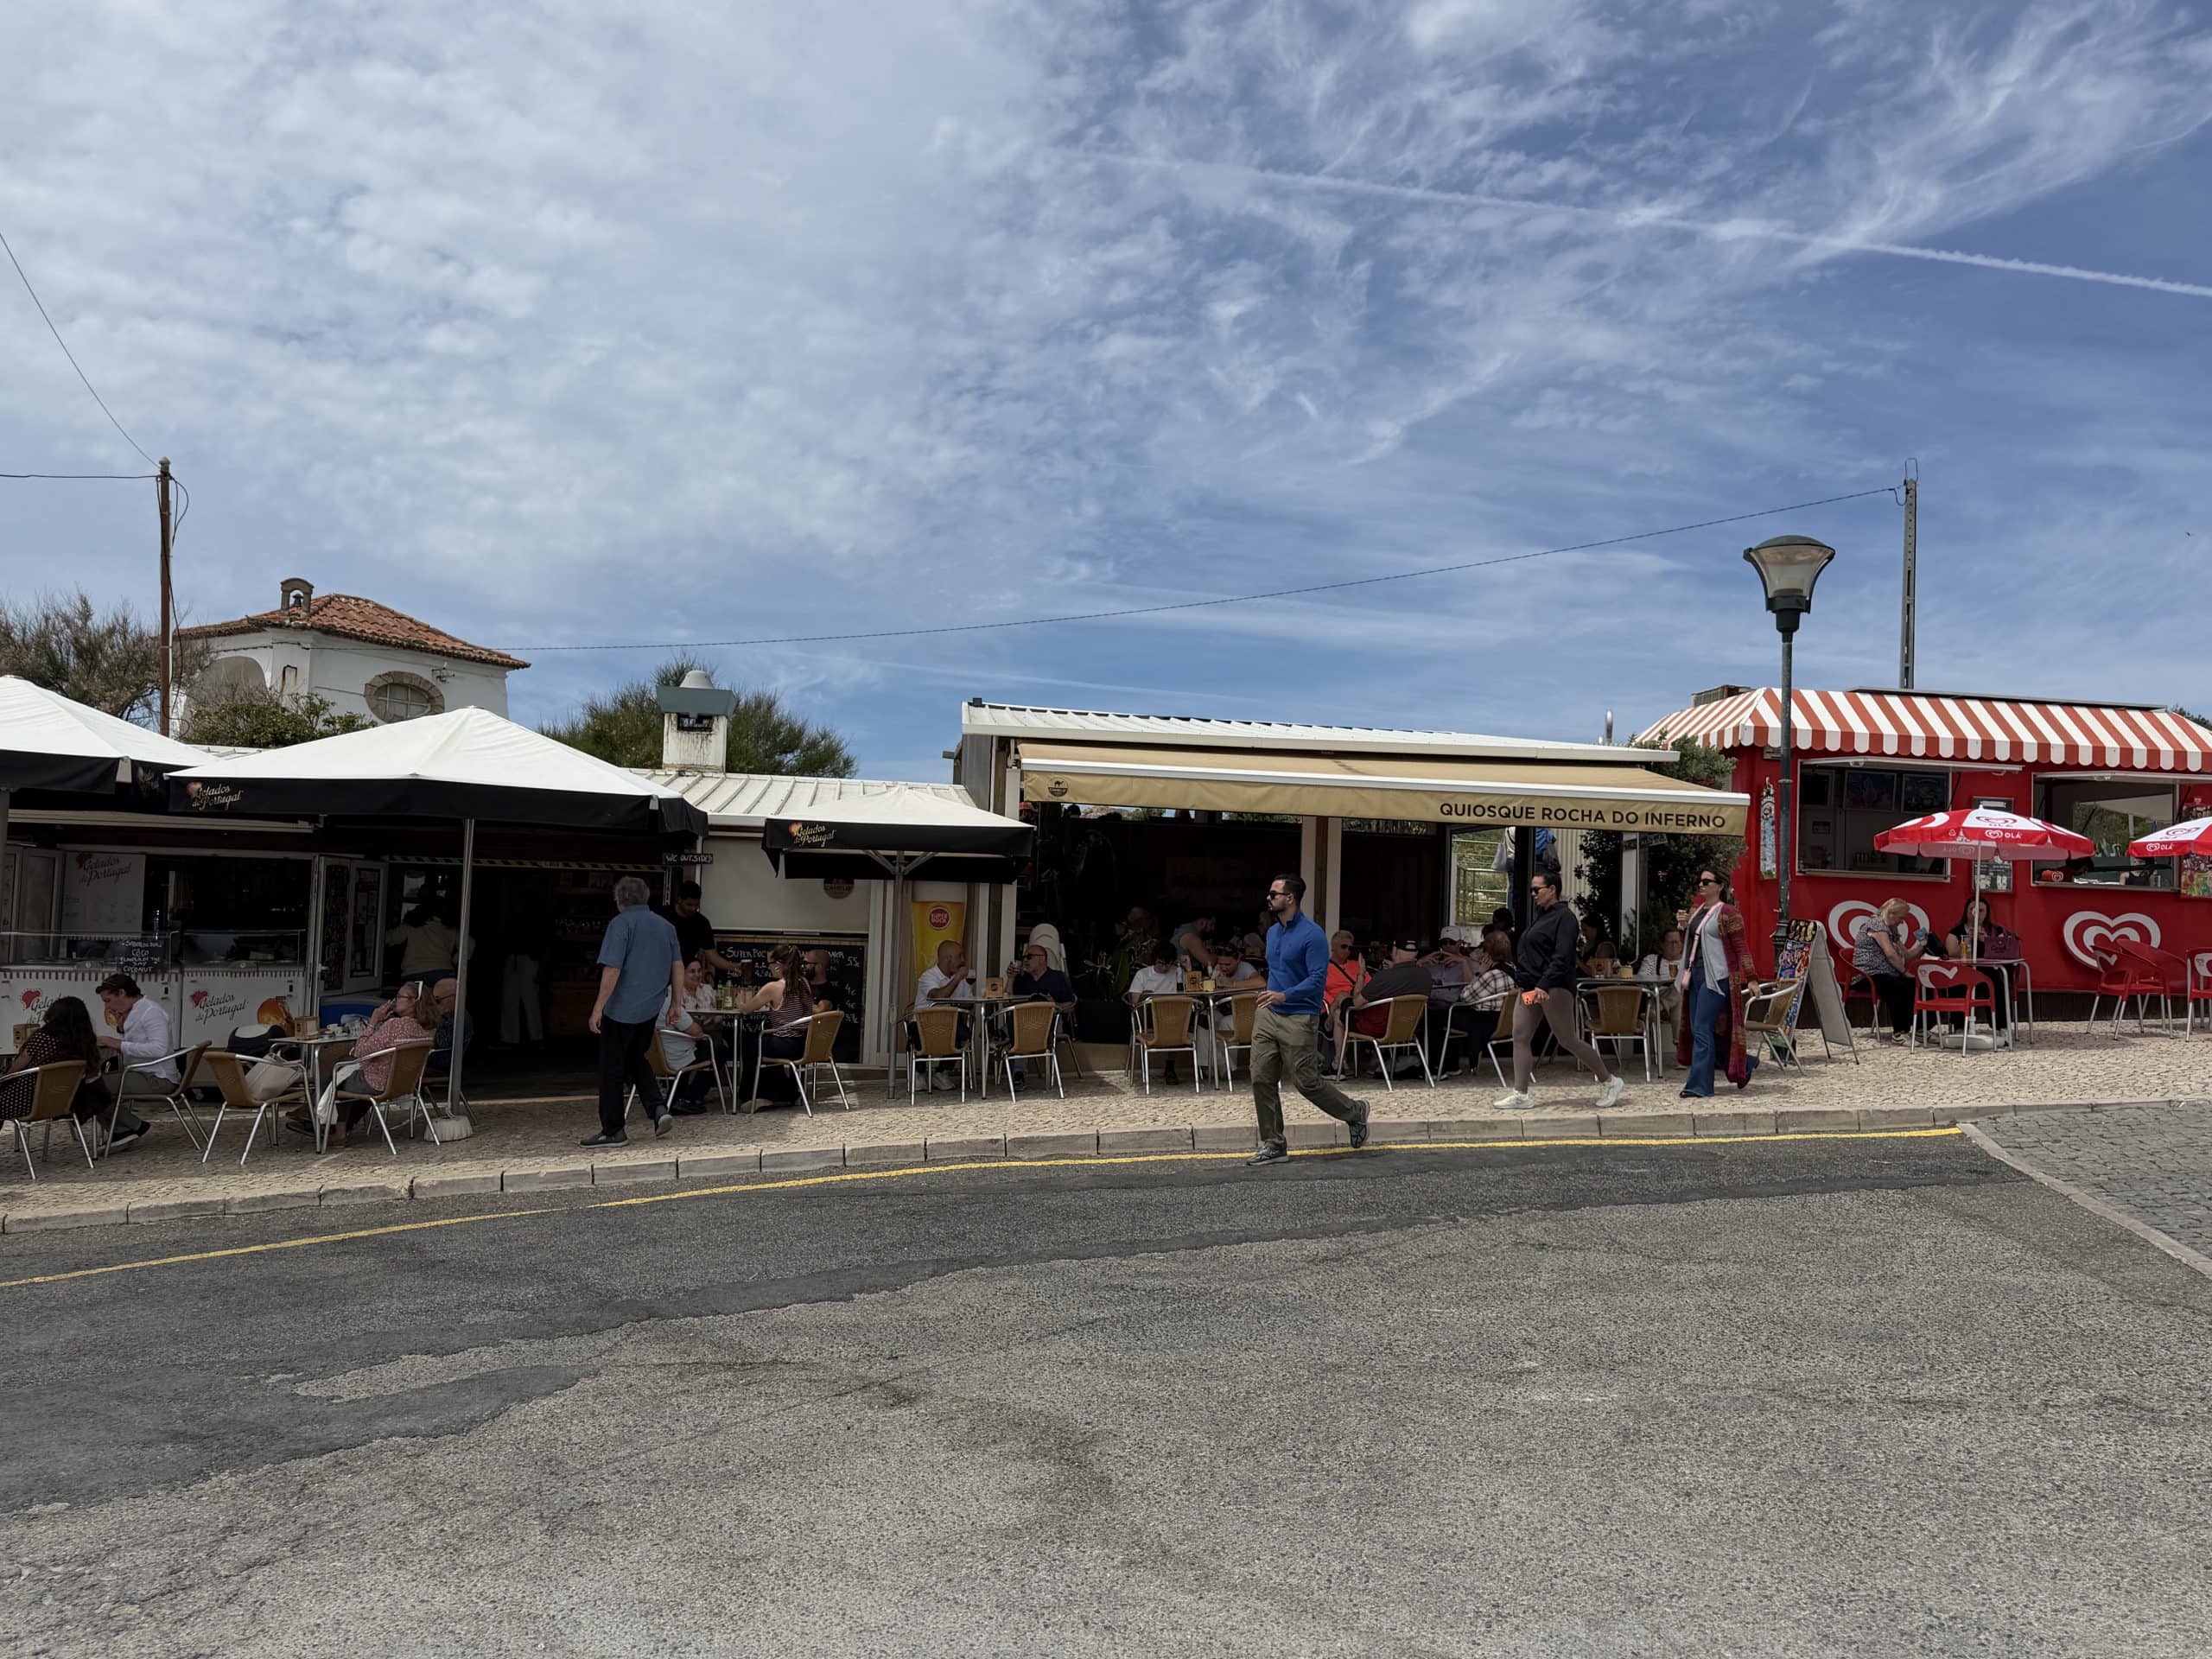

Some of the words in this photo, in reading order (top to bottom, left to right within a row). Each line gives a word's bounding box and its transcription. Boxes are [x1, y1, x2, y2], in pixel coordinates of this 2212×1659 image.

[199, 790, 243, 811] Portugal
[1440, 803, 1535, 820] QUIOSQUE
[1541, 808, 1605, 823] ROCHA
[1612, 811, 1638, 824] DO
[1644, 812, 1726, 828] INFERNO
[799, 830, 836, 848] Portugal
[753, 948, 768, 958] BOC
[200, 991, 235, 1010] Gelados
[202, 999, 246, 1025] Portugal
